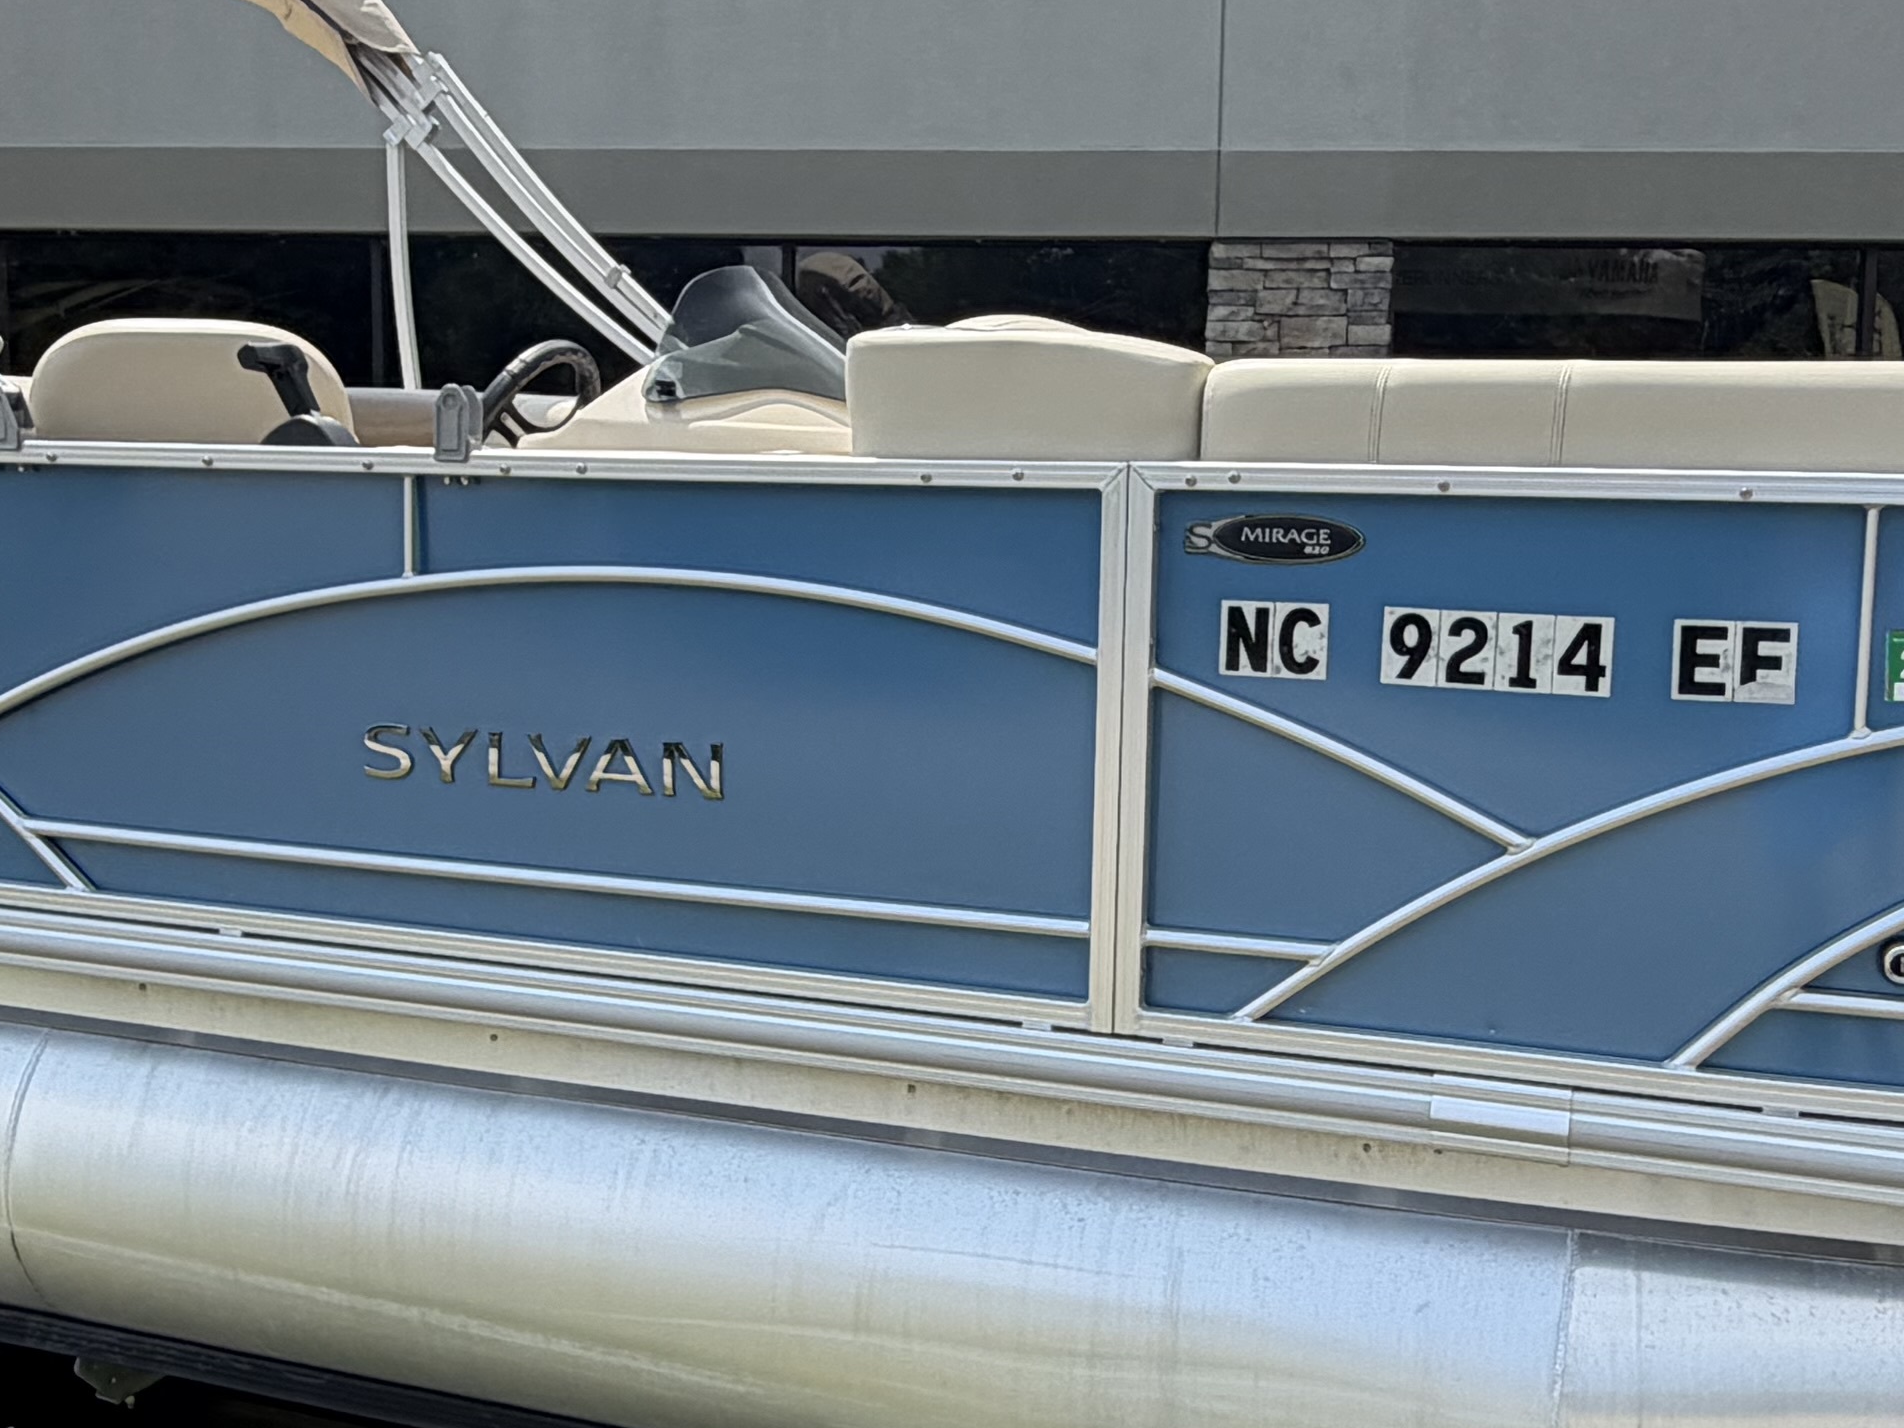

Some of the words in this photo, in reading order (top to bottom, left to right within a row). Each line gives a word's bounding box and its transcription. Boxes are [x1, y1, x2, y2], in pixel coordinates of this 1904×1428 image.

[1241, 527, 1331, 544] MIRAGE
[1225, 606, 1322, 675] NC
[1390, 613, 1607, 692] 9214
[1677, 625, 1791, 697] EF
[363, 723, 724, 801] SYLVAN
